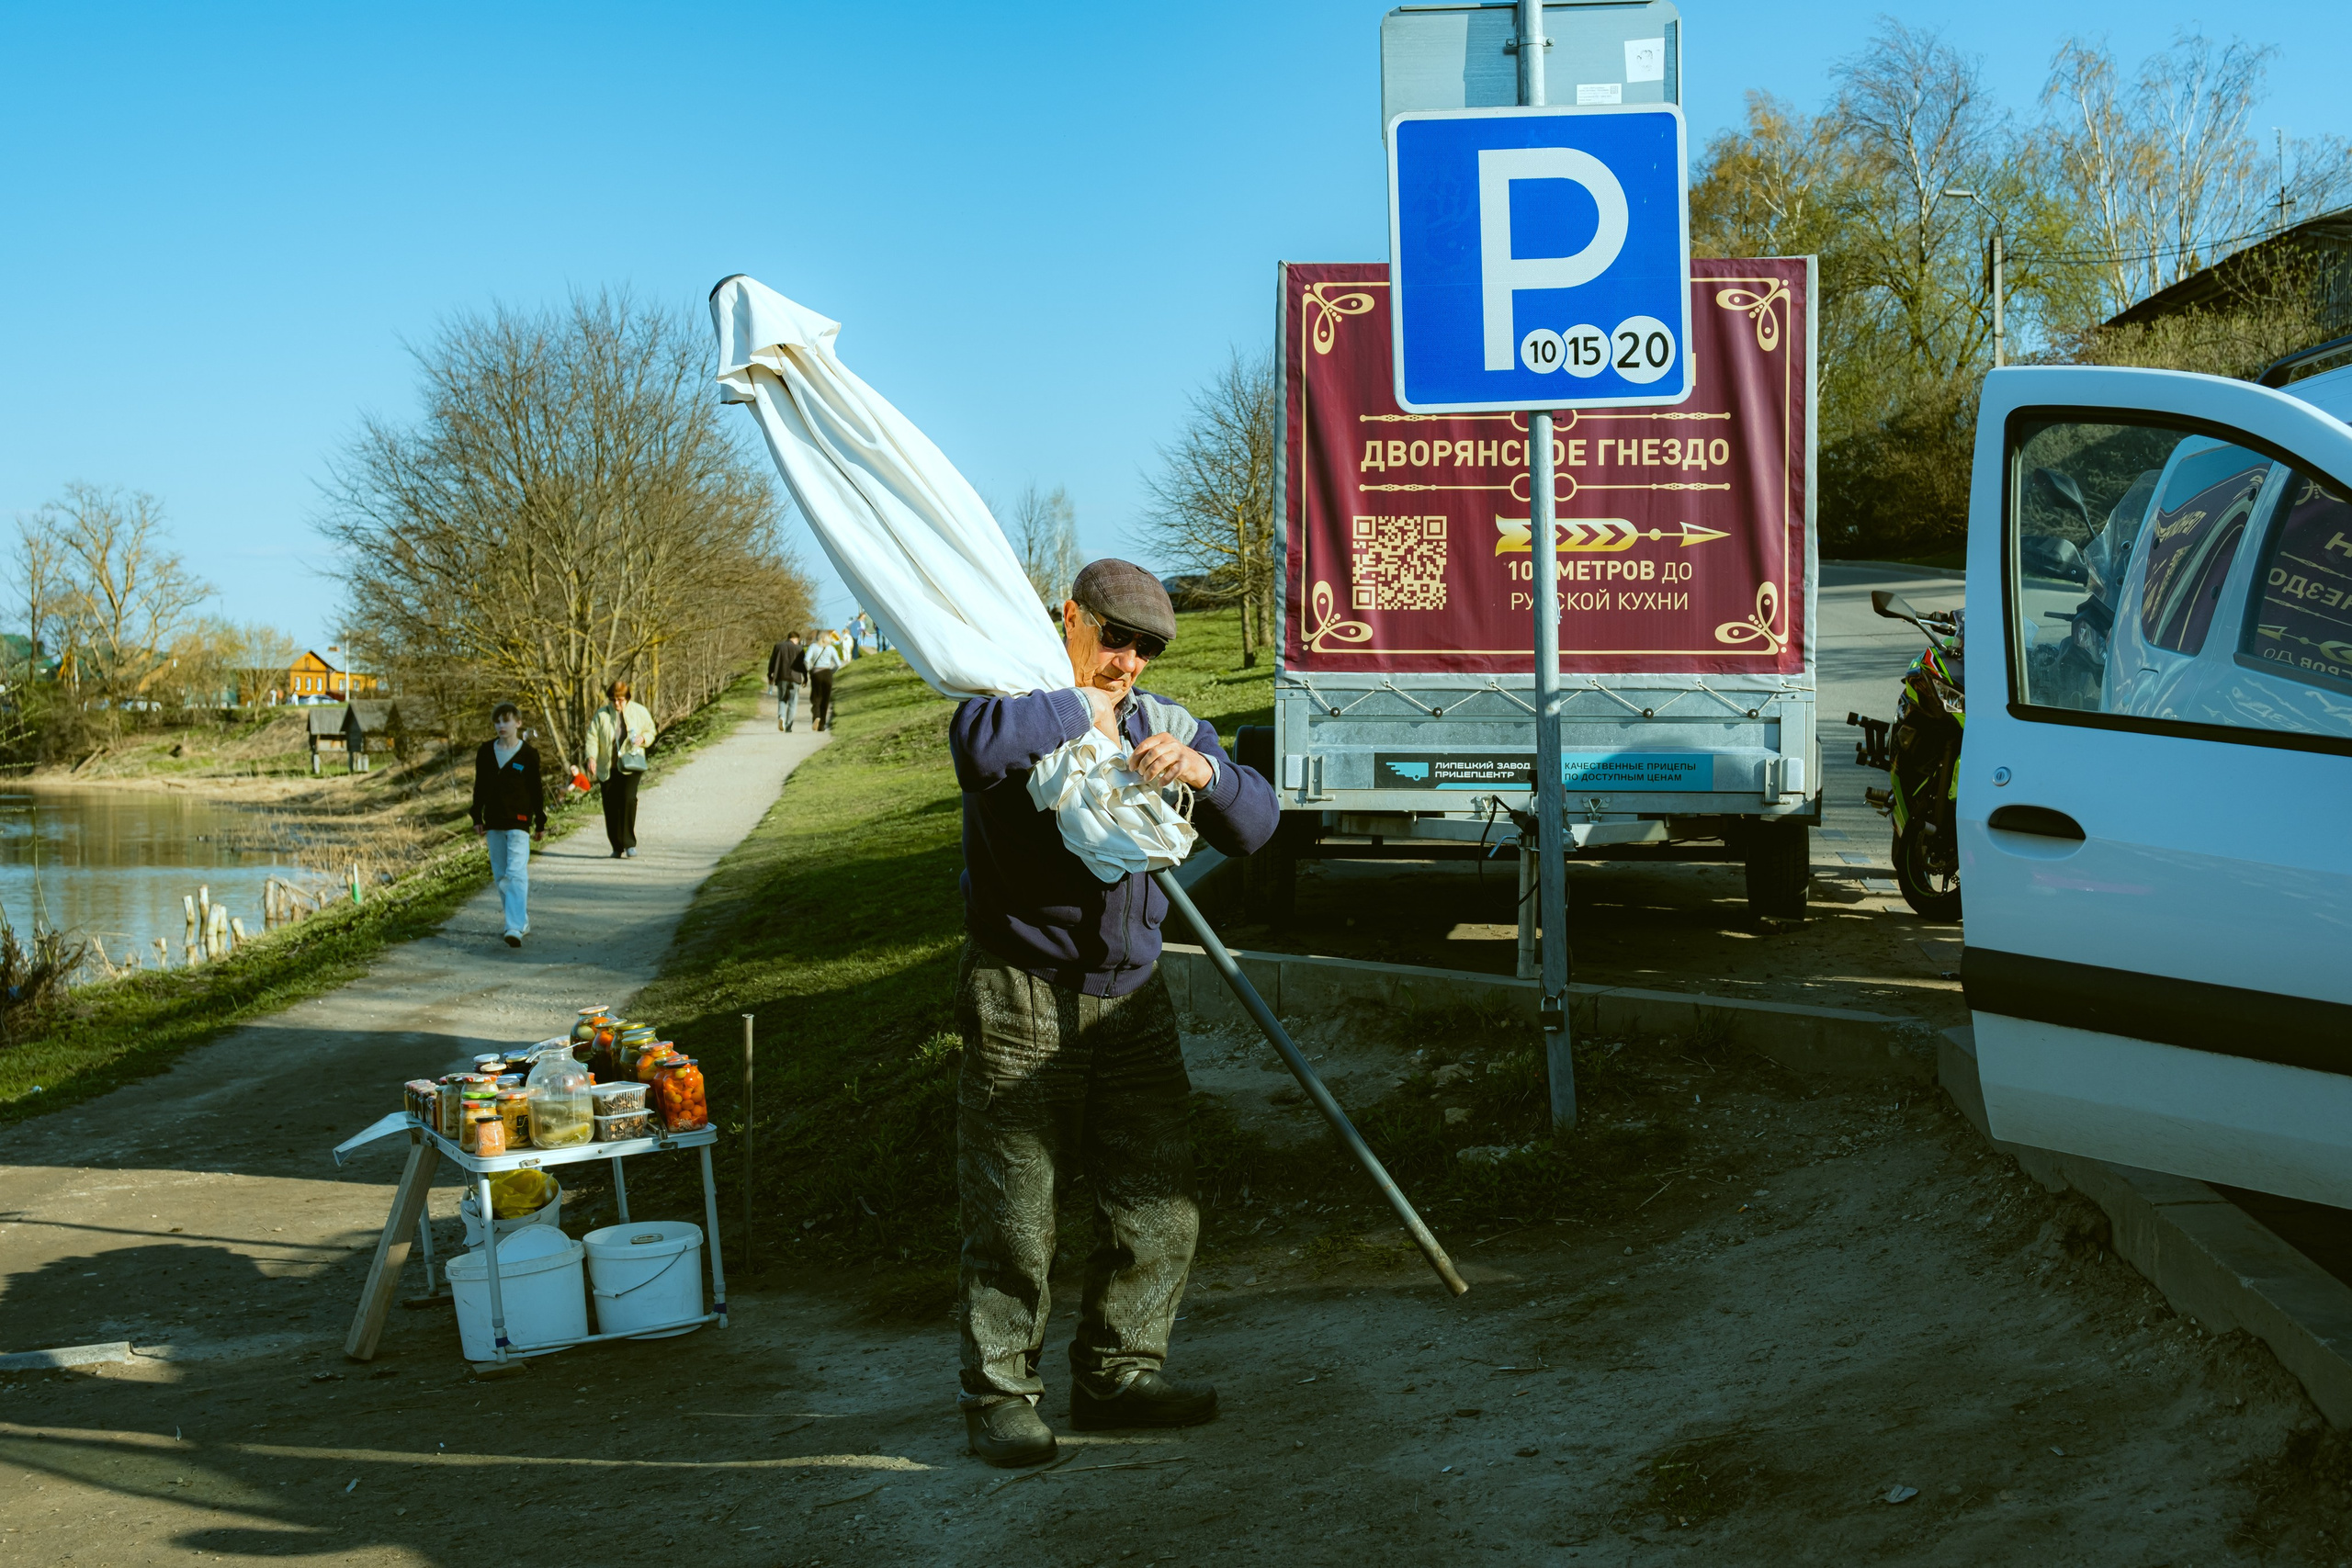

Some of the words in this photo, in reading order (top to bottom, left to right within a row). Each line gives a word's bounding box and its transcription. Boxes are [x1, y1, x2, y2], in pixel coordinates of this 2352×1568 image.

[1477, 147, 1629, 371] P
[1529, 340, 1557, 364] 10
[1568, 336, 1601, 366] 15
[1617, 331, 1669, 368] 20
[1361, 439, 1587, 472] ДВОРЯНСОЕ
[1598, 438, 1730, 470] ГНЕЗДО
[1508, 560, 1533, 581] 10
[1555, 560, 1656, 581] МЕТРОВ
[1661, 562, 1692, 584] ДО
[1511, 588, 1610, 611] РУСКОЙ
[1618, 592, 1689, 611] КУХНИ
[1434, 771, 1515, 779] ПРИЦЕПЦЕНТР
[1435, 761, 1494, 770] ЛИПЕЦКИЙ
[1497, 761, 1532, 770] ЗАВОД
[1565, 761, 1645, 771] КАЧЕСТВЕННЫЕ
[1646, 762, 1696, 772] ПРИЦЕПЫ
[1565, 773, 1578, 781] ПО
[1581, 773, 1645, 783] ДОСТУПНЫМ
[1646, 773, 1682, 783] ЦЕНАМ
